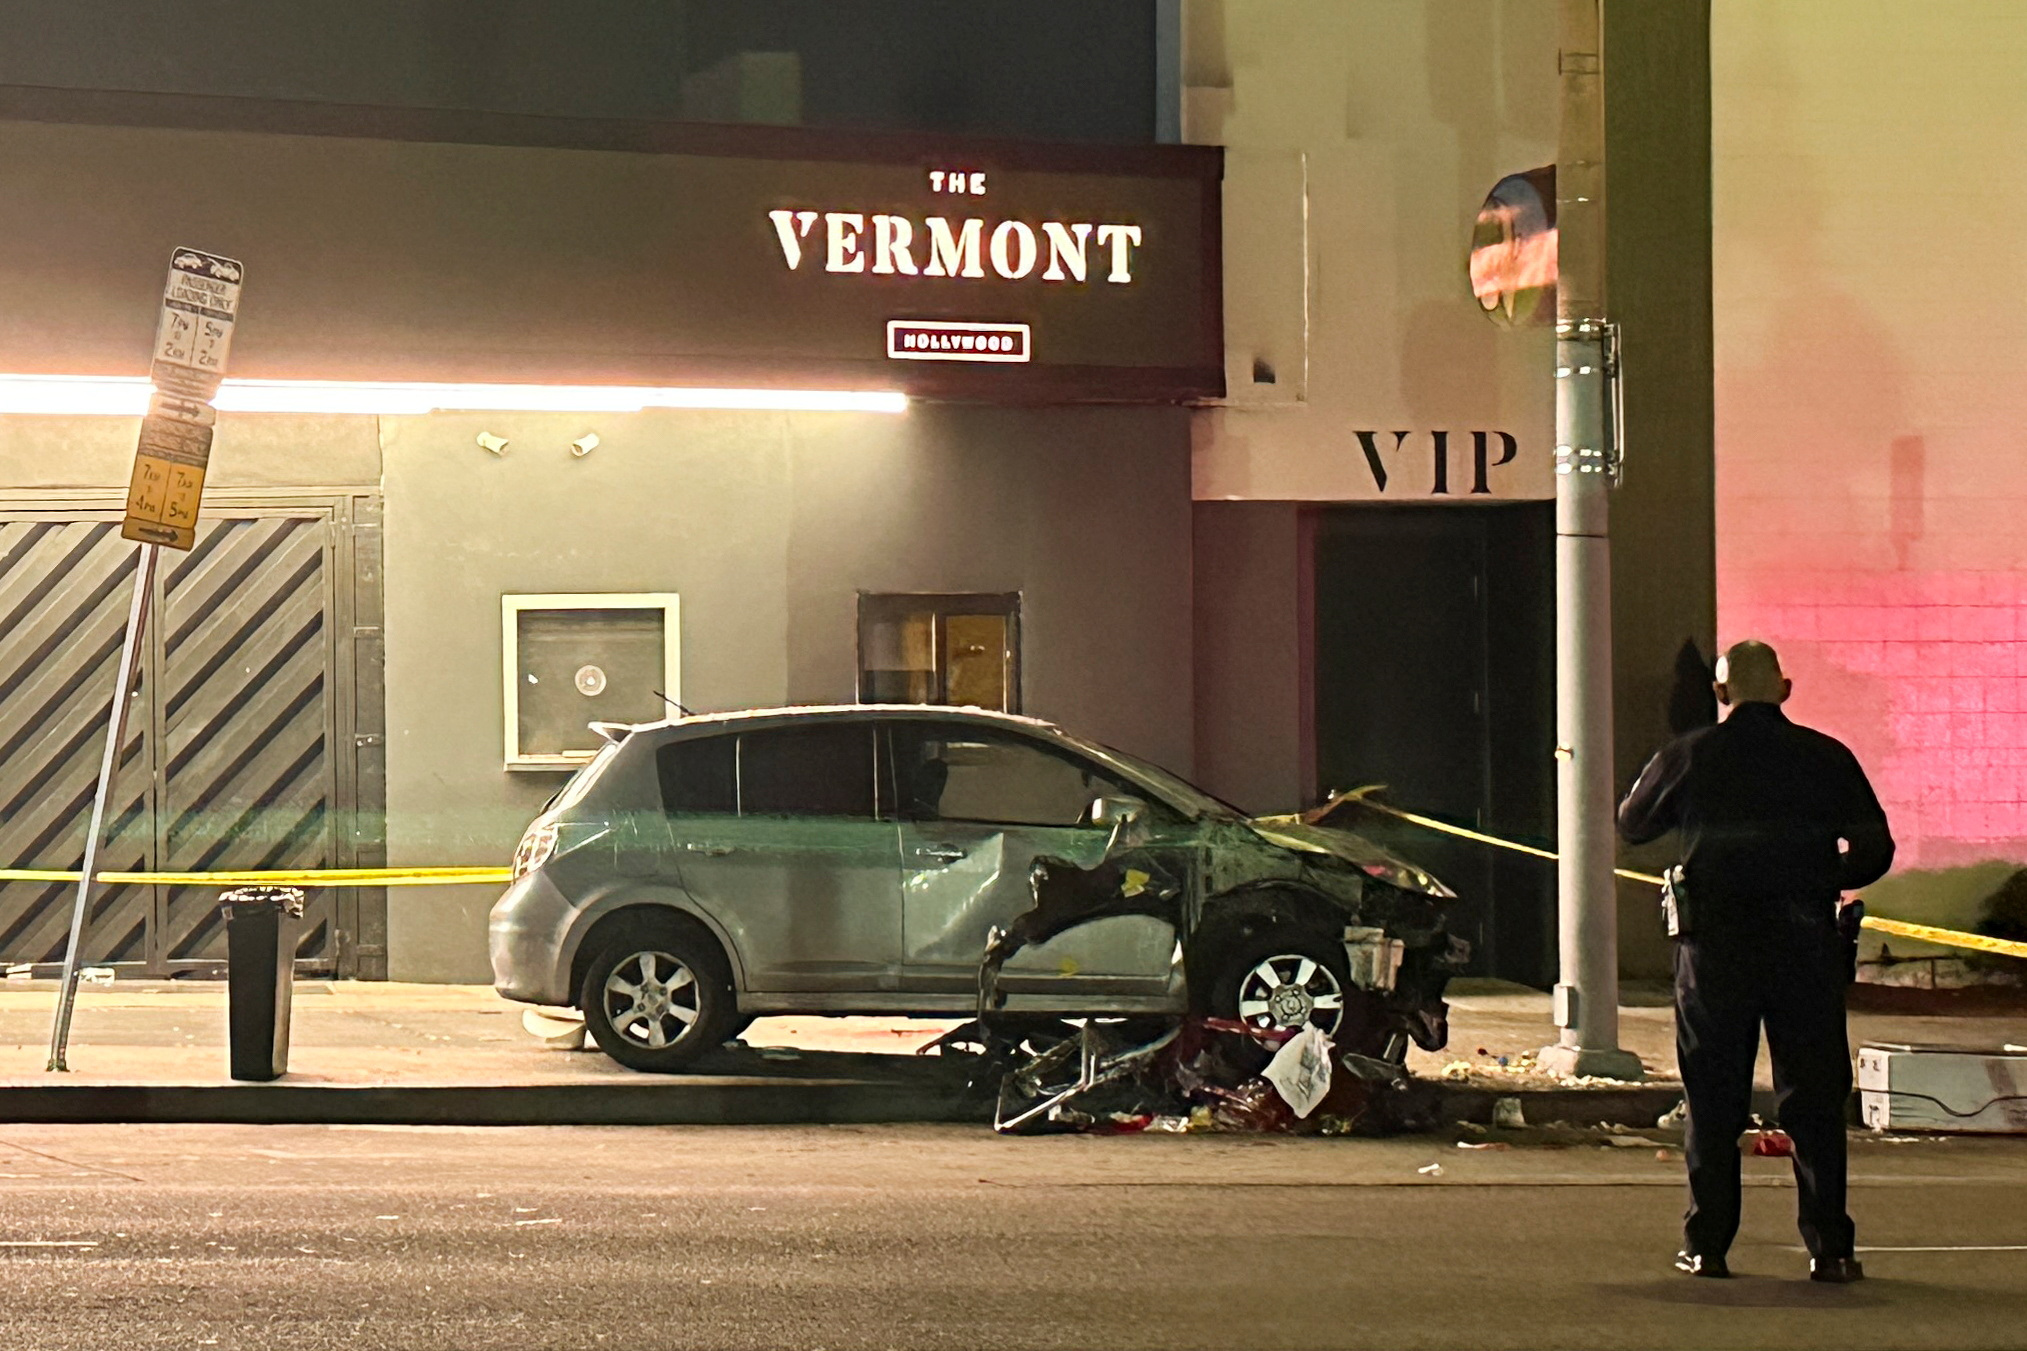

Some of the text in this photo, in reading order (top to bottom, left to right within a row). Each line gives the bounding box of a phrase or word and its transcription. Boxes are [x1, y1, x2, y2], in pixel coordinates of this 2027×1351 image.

[929, 171, 986, 195] THE
[768, 210, 1142, 283] VERMONT
[903, 333, 1013, 351] HOLLYWOOD
[1352, 430, 1517, 494] VIP
